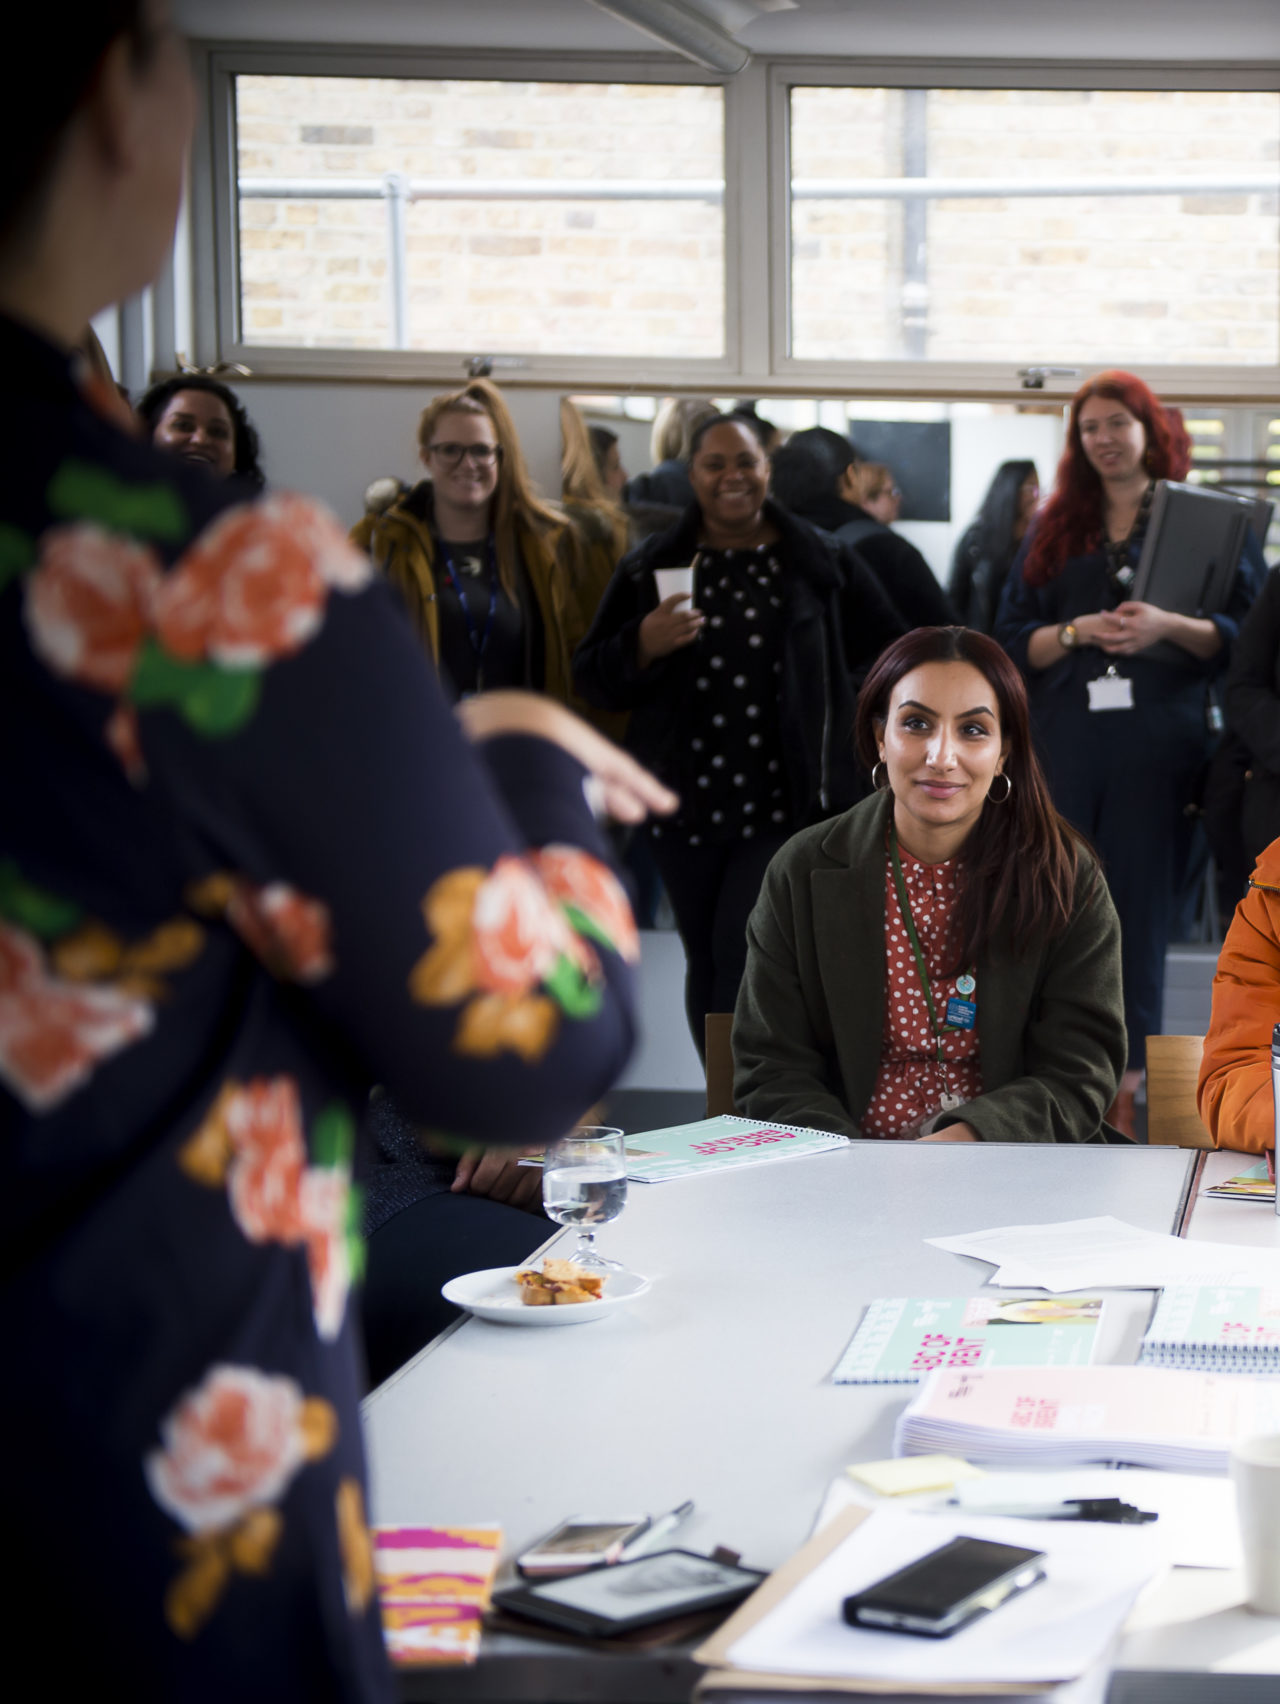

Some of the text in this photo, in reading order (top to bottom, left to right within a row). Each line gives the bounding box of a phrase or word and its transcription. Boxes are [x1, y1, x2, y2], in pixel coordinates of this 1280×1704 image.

[688, 1129, 782, 1150] BRENT
[696, 1132, 797, 1156] ABC OF
